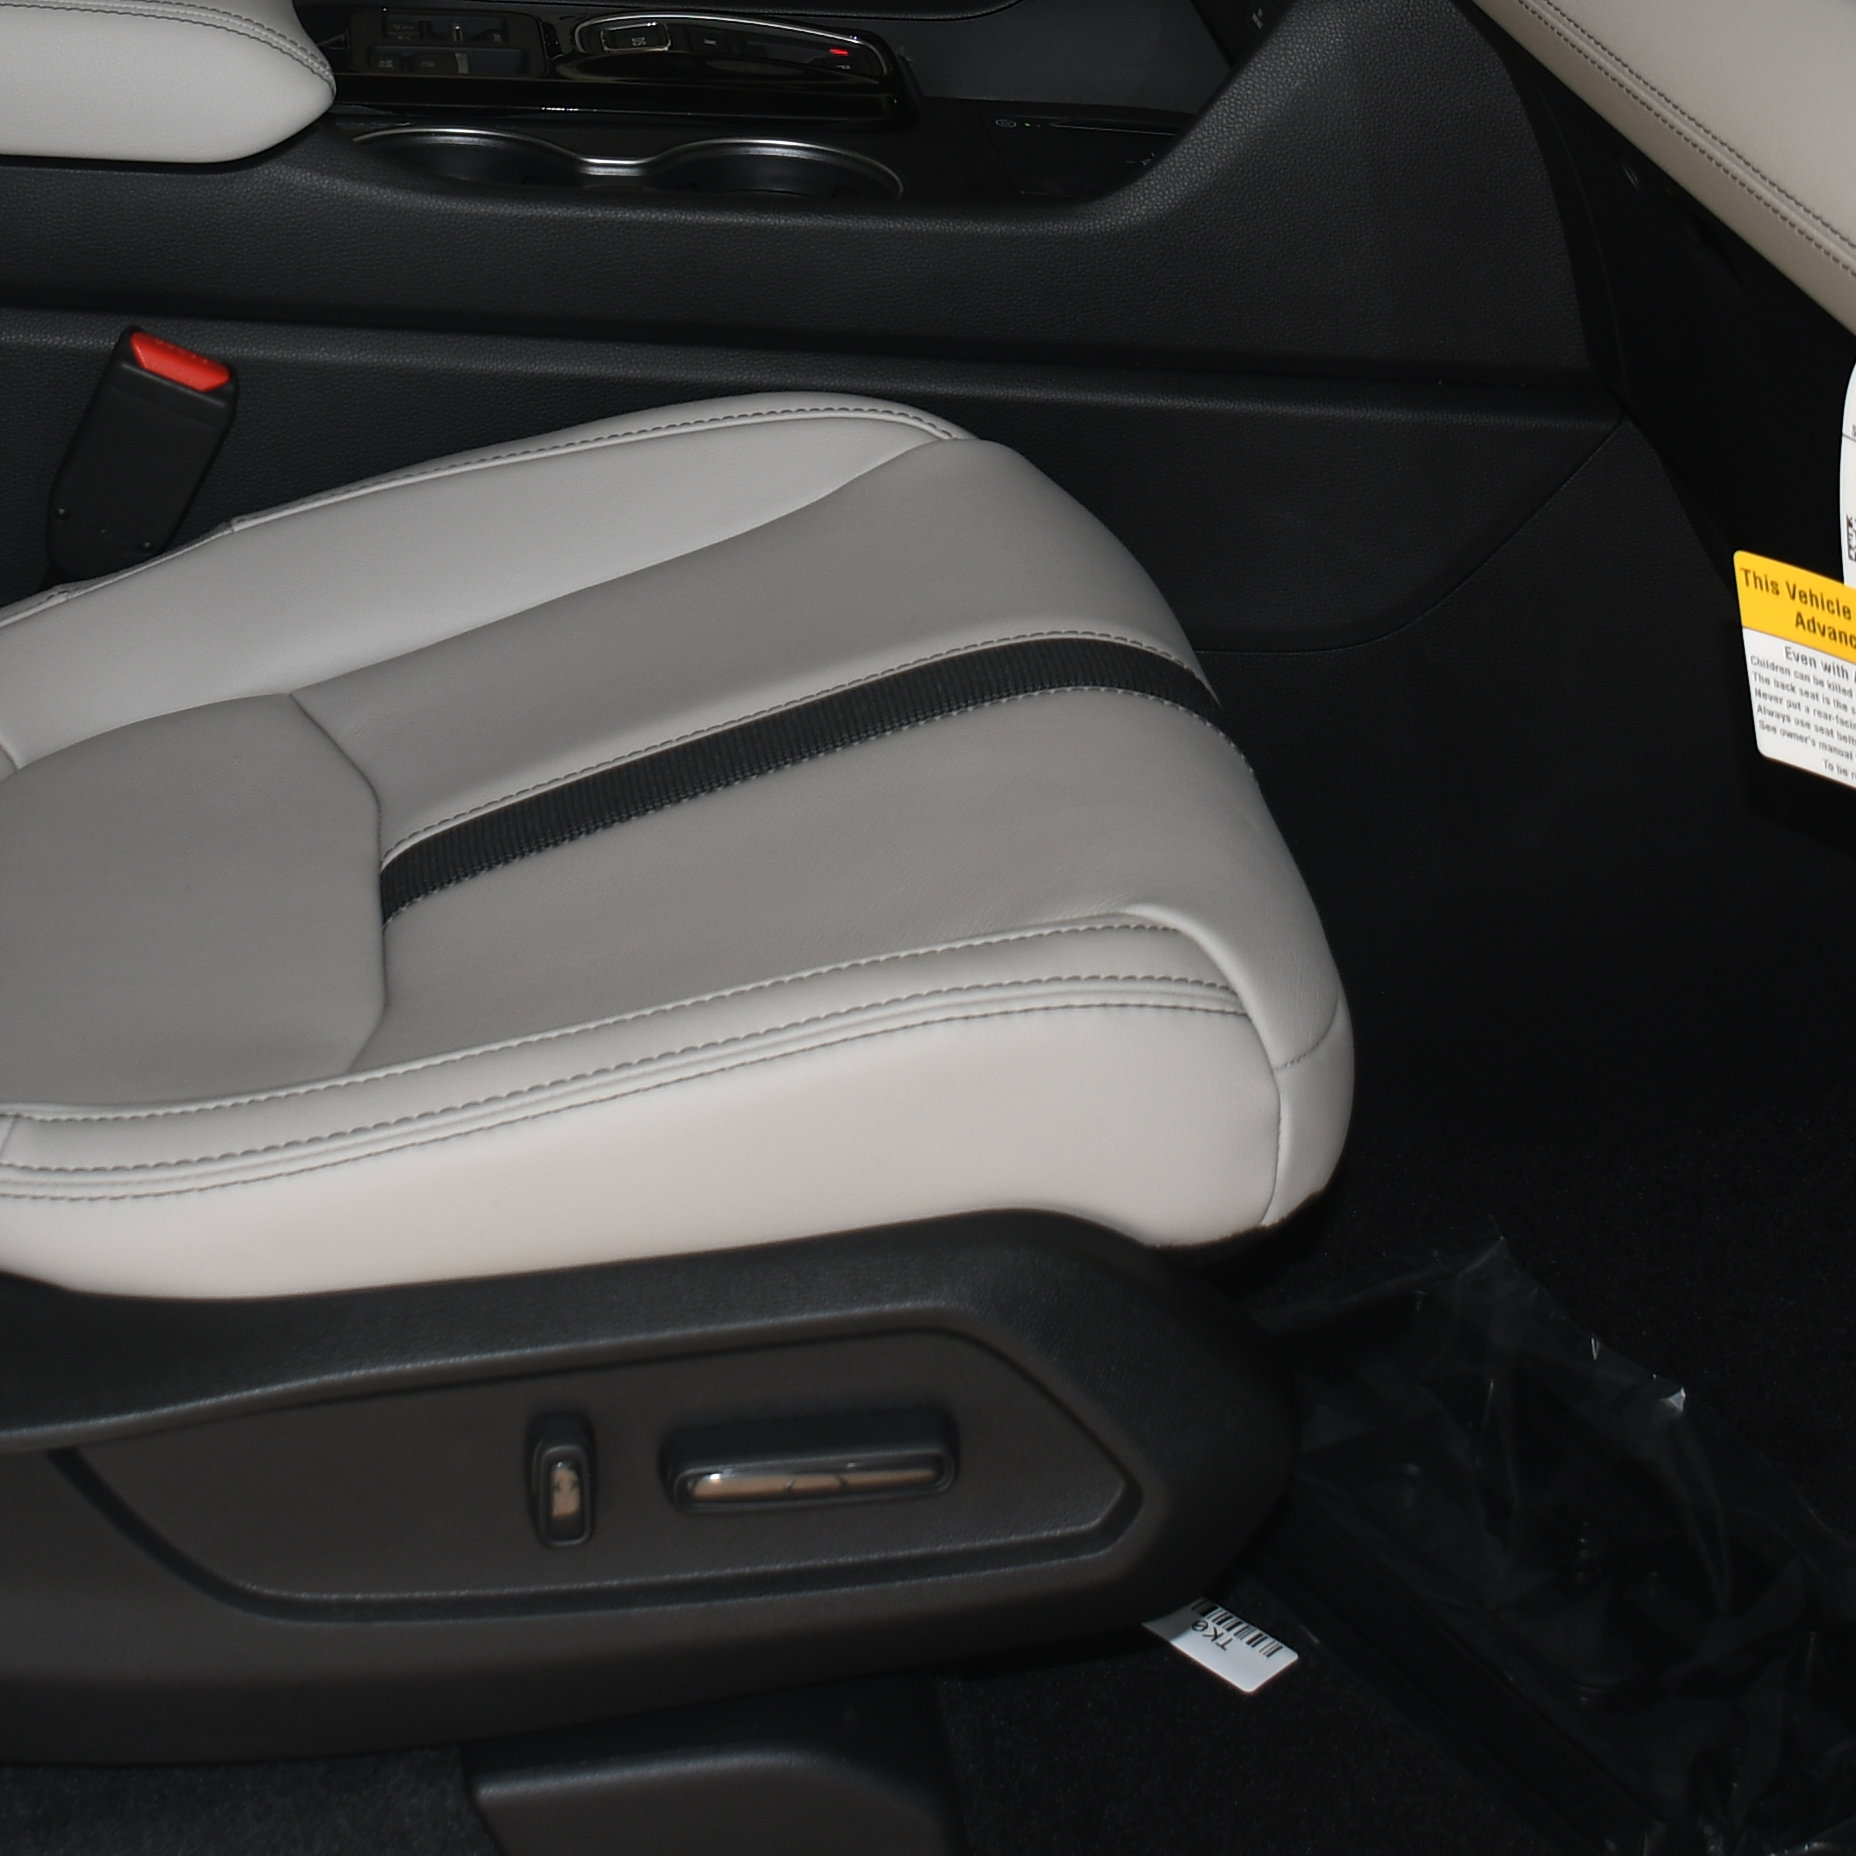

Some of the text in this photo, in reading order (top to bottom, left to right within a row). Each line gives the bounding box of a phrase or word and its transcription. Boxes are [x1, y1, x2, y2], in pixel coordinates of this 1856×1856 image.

[1740, 567, 1780, 596] This
[1785, 581, 1851, 620] Vehicle
[1750, 655, 1791, 676] Children
[1794, 670, 1810, 683] can
[1812, 674, 1825, 687] be
[1827, 680, 1853, 698] killed
[1784, 646, 1817, 669] Even
[1821, 661, 1849, 680] with
[1753, 671, 1770, 686] The
[1773, 677, 1796, 693] back
[1798, 687, 1819, 702] seat
[1822, 695, 1831, 705] is
[1833, 698, 1848, 712] the
[1754, 688, 1783, 704] Never
[1786, 699, 1801, 711] put
[1805, 706, 1810, 714] a
[1757, 704, 1791, 724] Always
[1794, 717, 1811, 730] use
[1813, 724, 1834, 738] seat
[1758, 720, 1777, 734] See
[1780, 729, 1816, 747] owner's
[1818, 741, 1853, 760] manual
[1823, 759, 1834, 772] To
[1836, 764, 1848, 777] be
